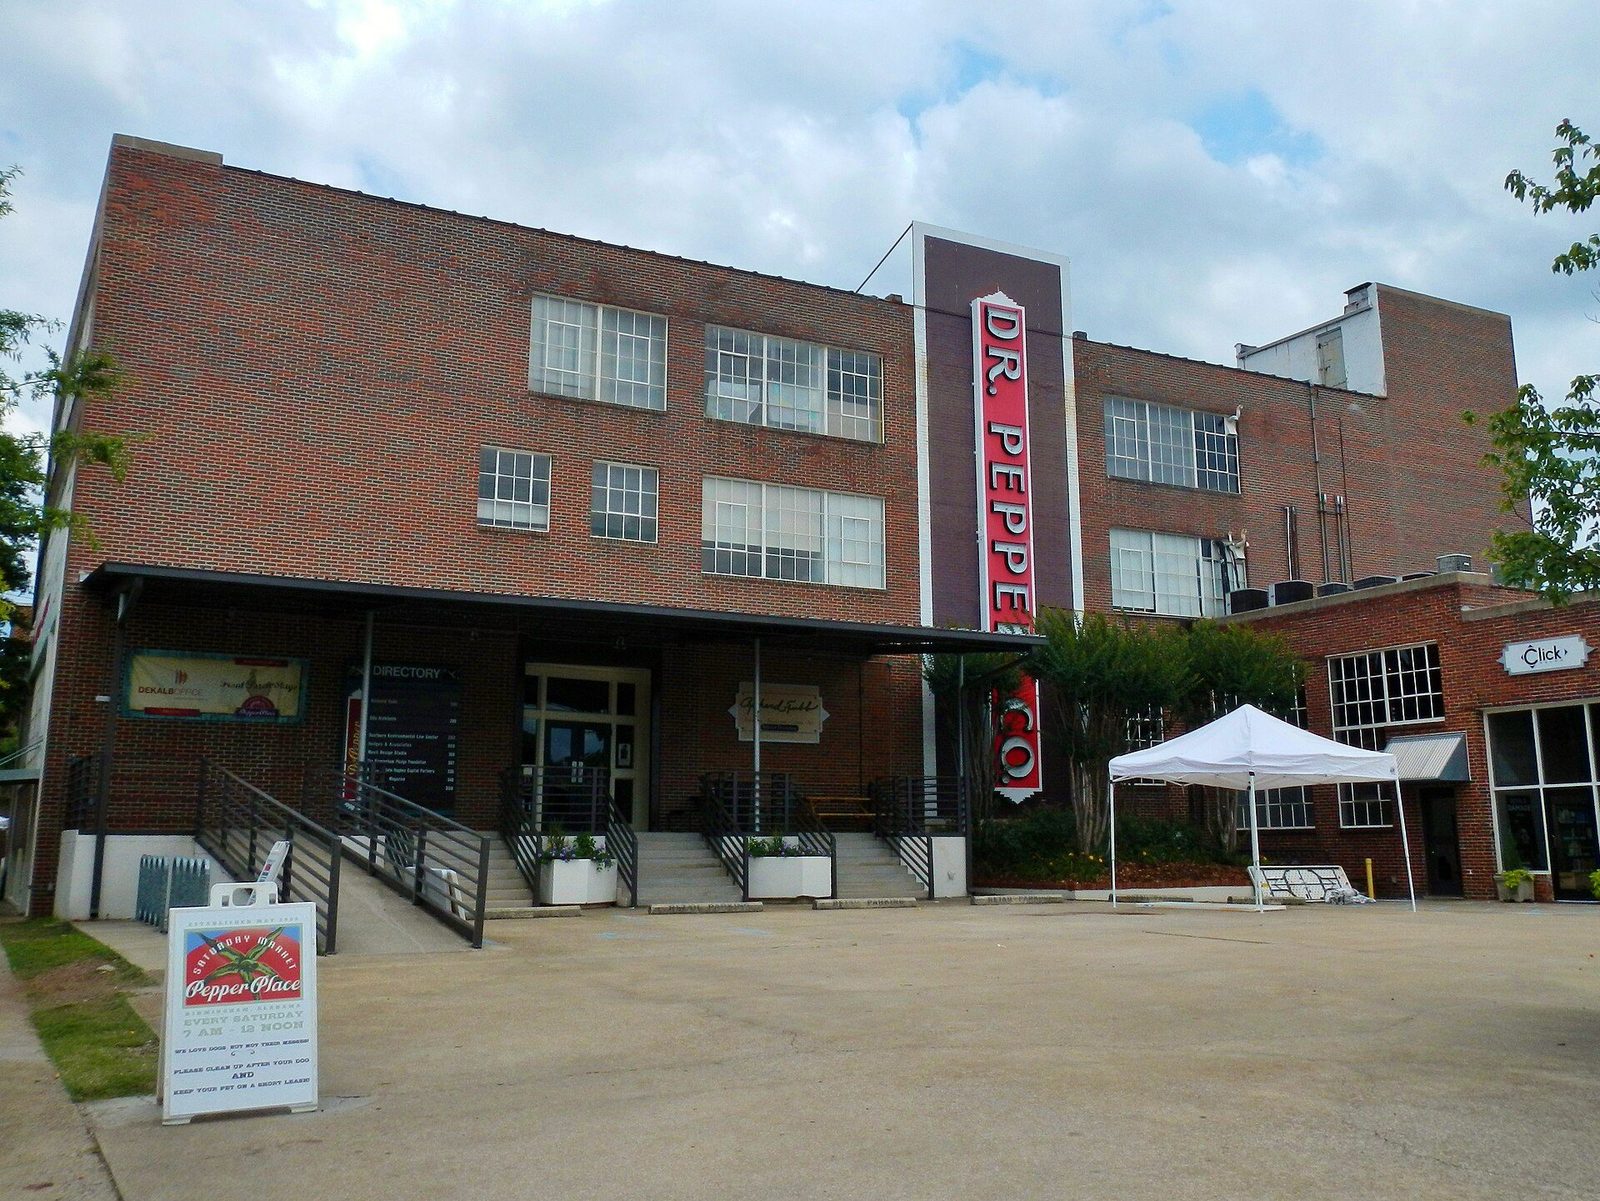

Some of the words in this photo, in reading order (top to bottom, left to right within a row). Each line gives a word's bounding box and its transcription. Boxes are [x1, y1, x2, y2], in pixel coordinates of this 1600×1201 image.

[984, 304, 1021, 396] DR.
[1523, 645, 1562, 665] Click
[1000, 697, 1034, 784] CO.
[193, 935, 251, 975] SATURDAY
[257, 936, 297, 970] MARKET
[185, 979, 250, 1002] Pepper
[249, 975, 301, 994] Place
[184, 1016, 228, 1027] EVERY
[233, 1010, 304, 1023] SATURDAY
[183, 1030, 191, 1038] 7
[198, 1026, 223, 1037] AM
[240, 1024, 255, 1034] 12
[260, 1020, 304, 1032] NOON
[173, 1067, 204, 1075] PLEASE
[205, 1064, 231, 1072] CLEAN
[246, 1061, 271, 1069] AFTER
[231, 1071, 255, 1080] AND
[173, 1088, 194, 1096] KEEP
